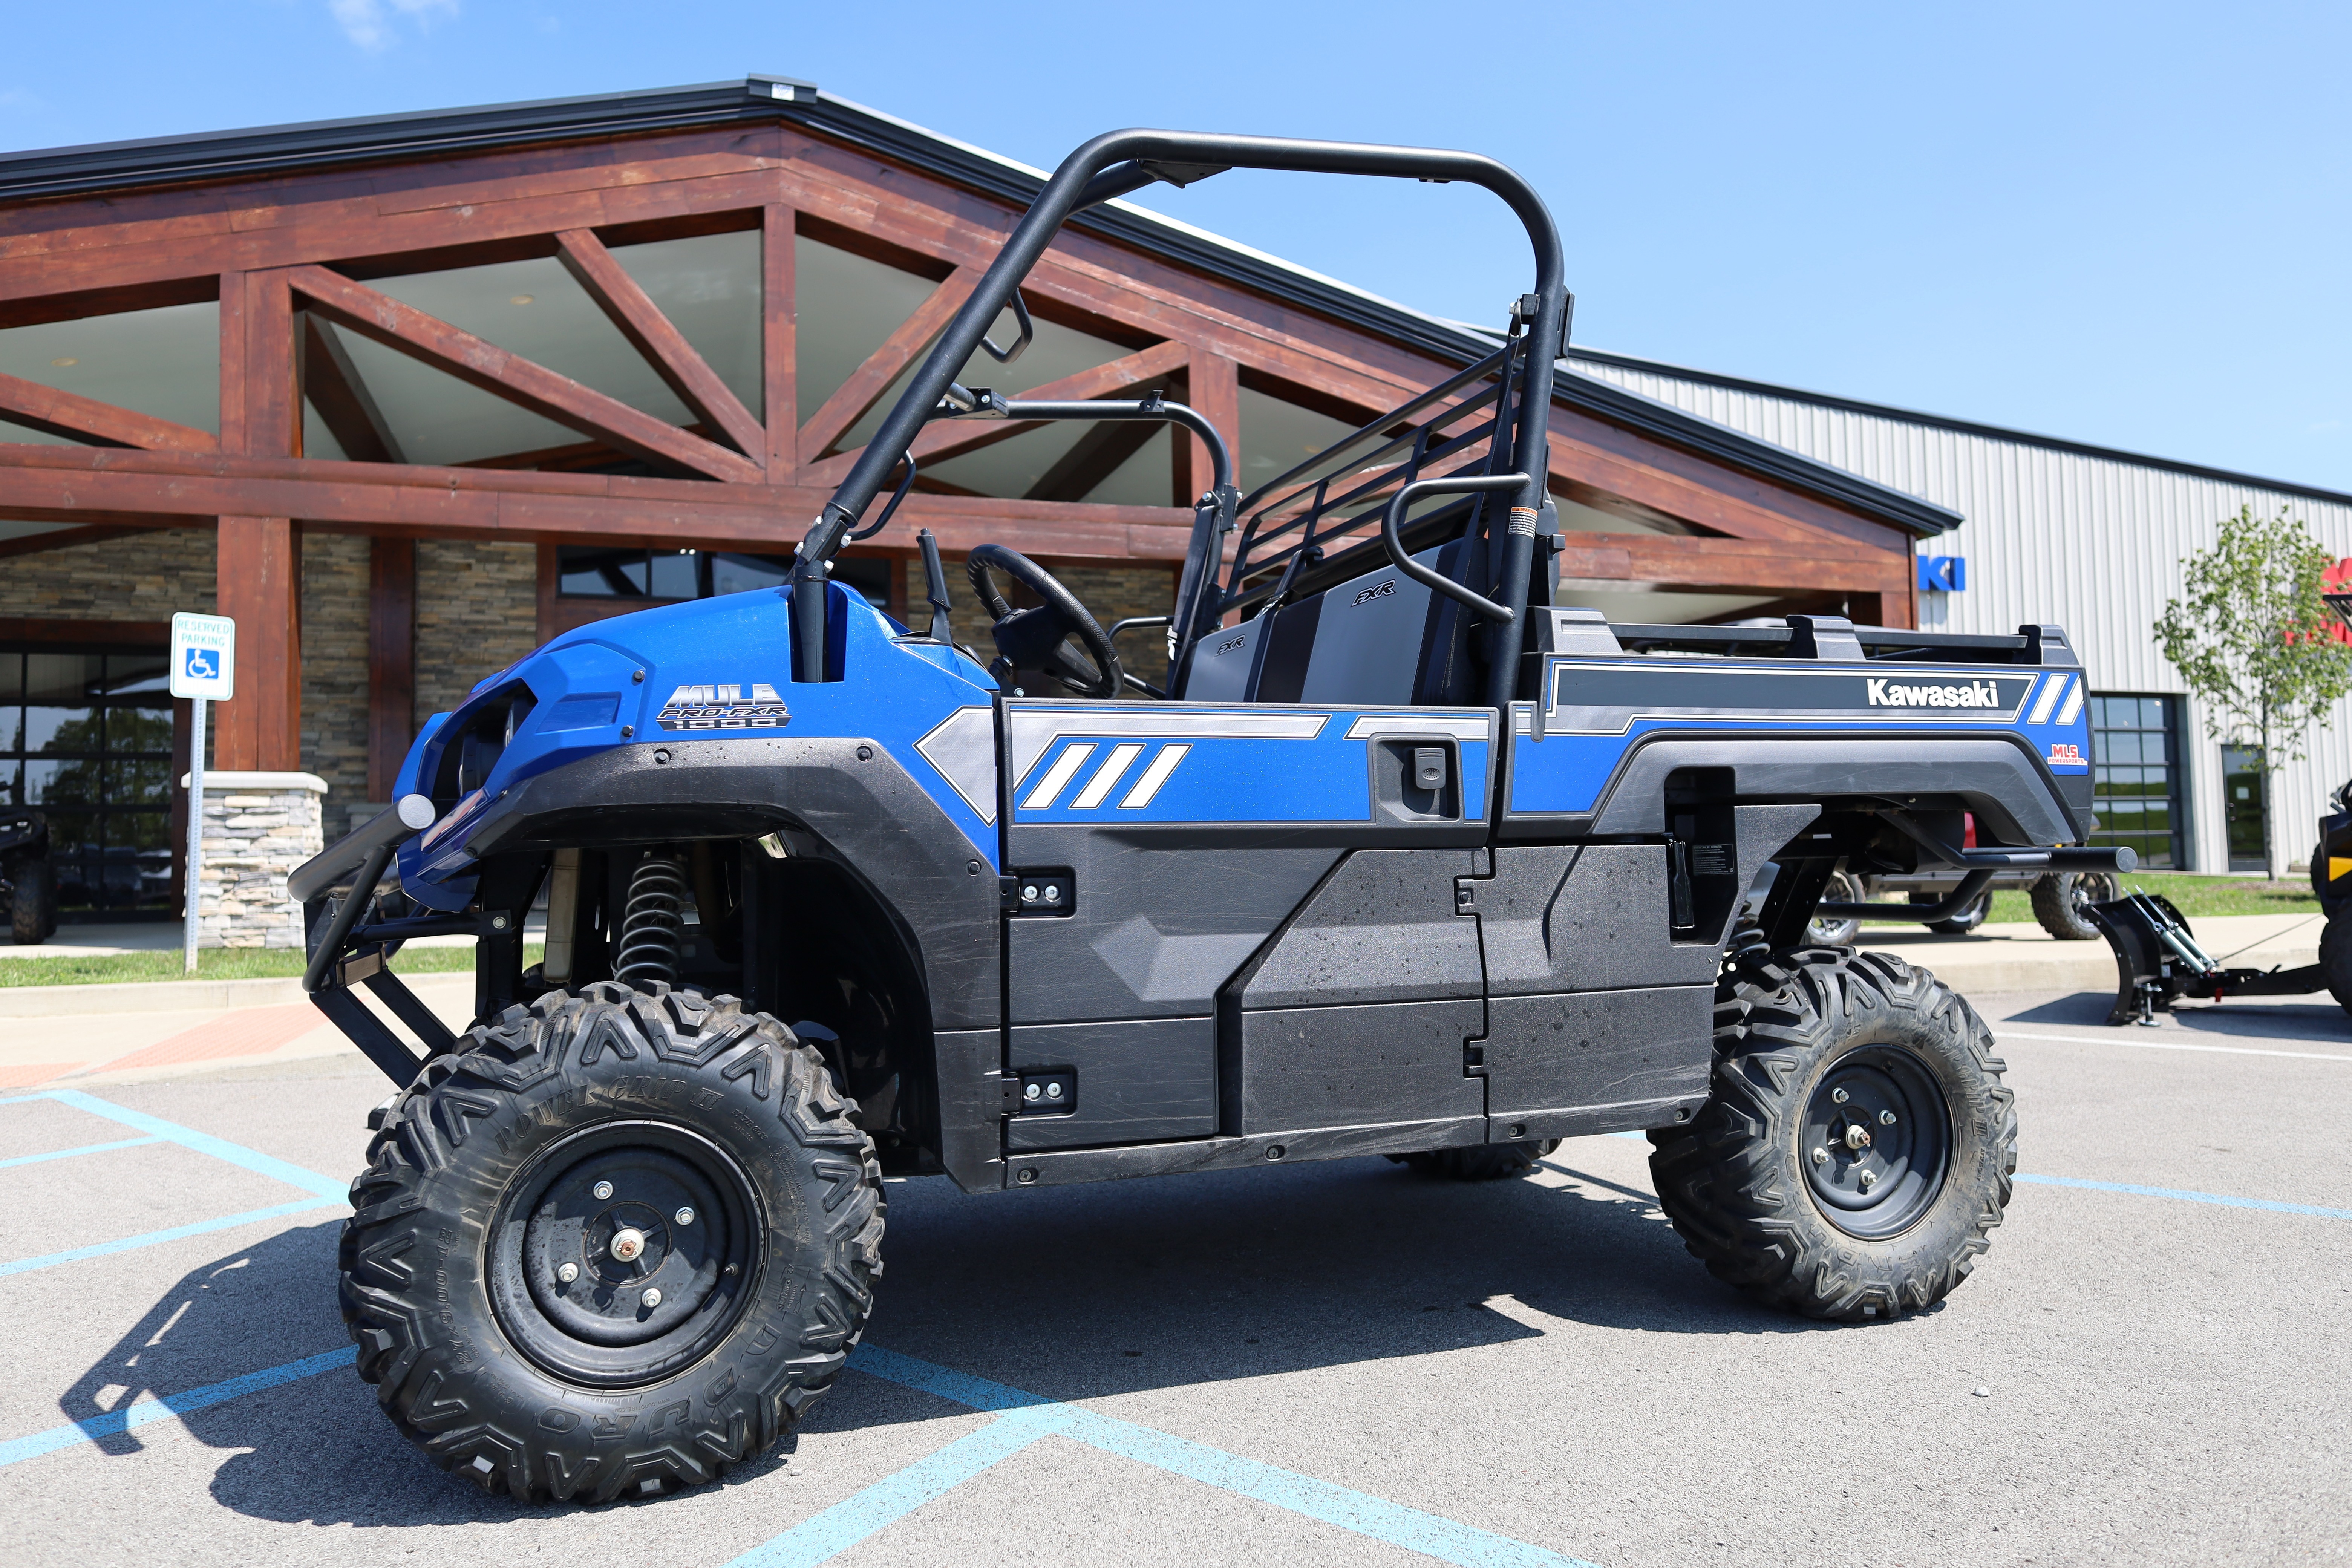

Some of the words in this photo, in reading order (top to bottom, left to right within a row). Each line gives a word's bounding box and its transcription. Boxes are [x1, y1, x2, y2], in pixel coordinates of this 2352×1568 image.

[1351, 579, 1397, 607] FXR
[178, 620, 229, 634] RESERVED
[182, 634, 225, 646] PARKING
[1214, 634, 1246, 658] FXR
[664, 683, 785, 708] MULE
[1866, 678, 2000, 708] Kawasaki
[656, 706, 790, 719] PRO-FXR
[674, 718, 777, 729] 1000
[2053, 746, 2077, 758] MLS
[495, 1083, 596, 1156] POWER
[607, 1076, 687, 1099] GRIP
[689, 1087, 724, 1112] II
[732, 1109, 768, 1140] NYLON
[779, 1160, 794, 1186] OPERATING
[792, 1187, 801, 1212] PRESSURE
[800, 1194, 805, 1204] OR
[536, 1366, 738, 1440] DURO
[615, 1397, 671, 1413] WWW.DUROTIRE.COM
